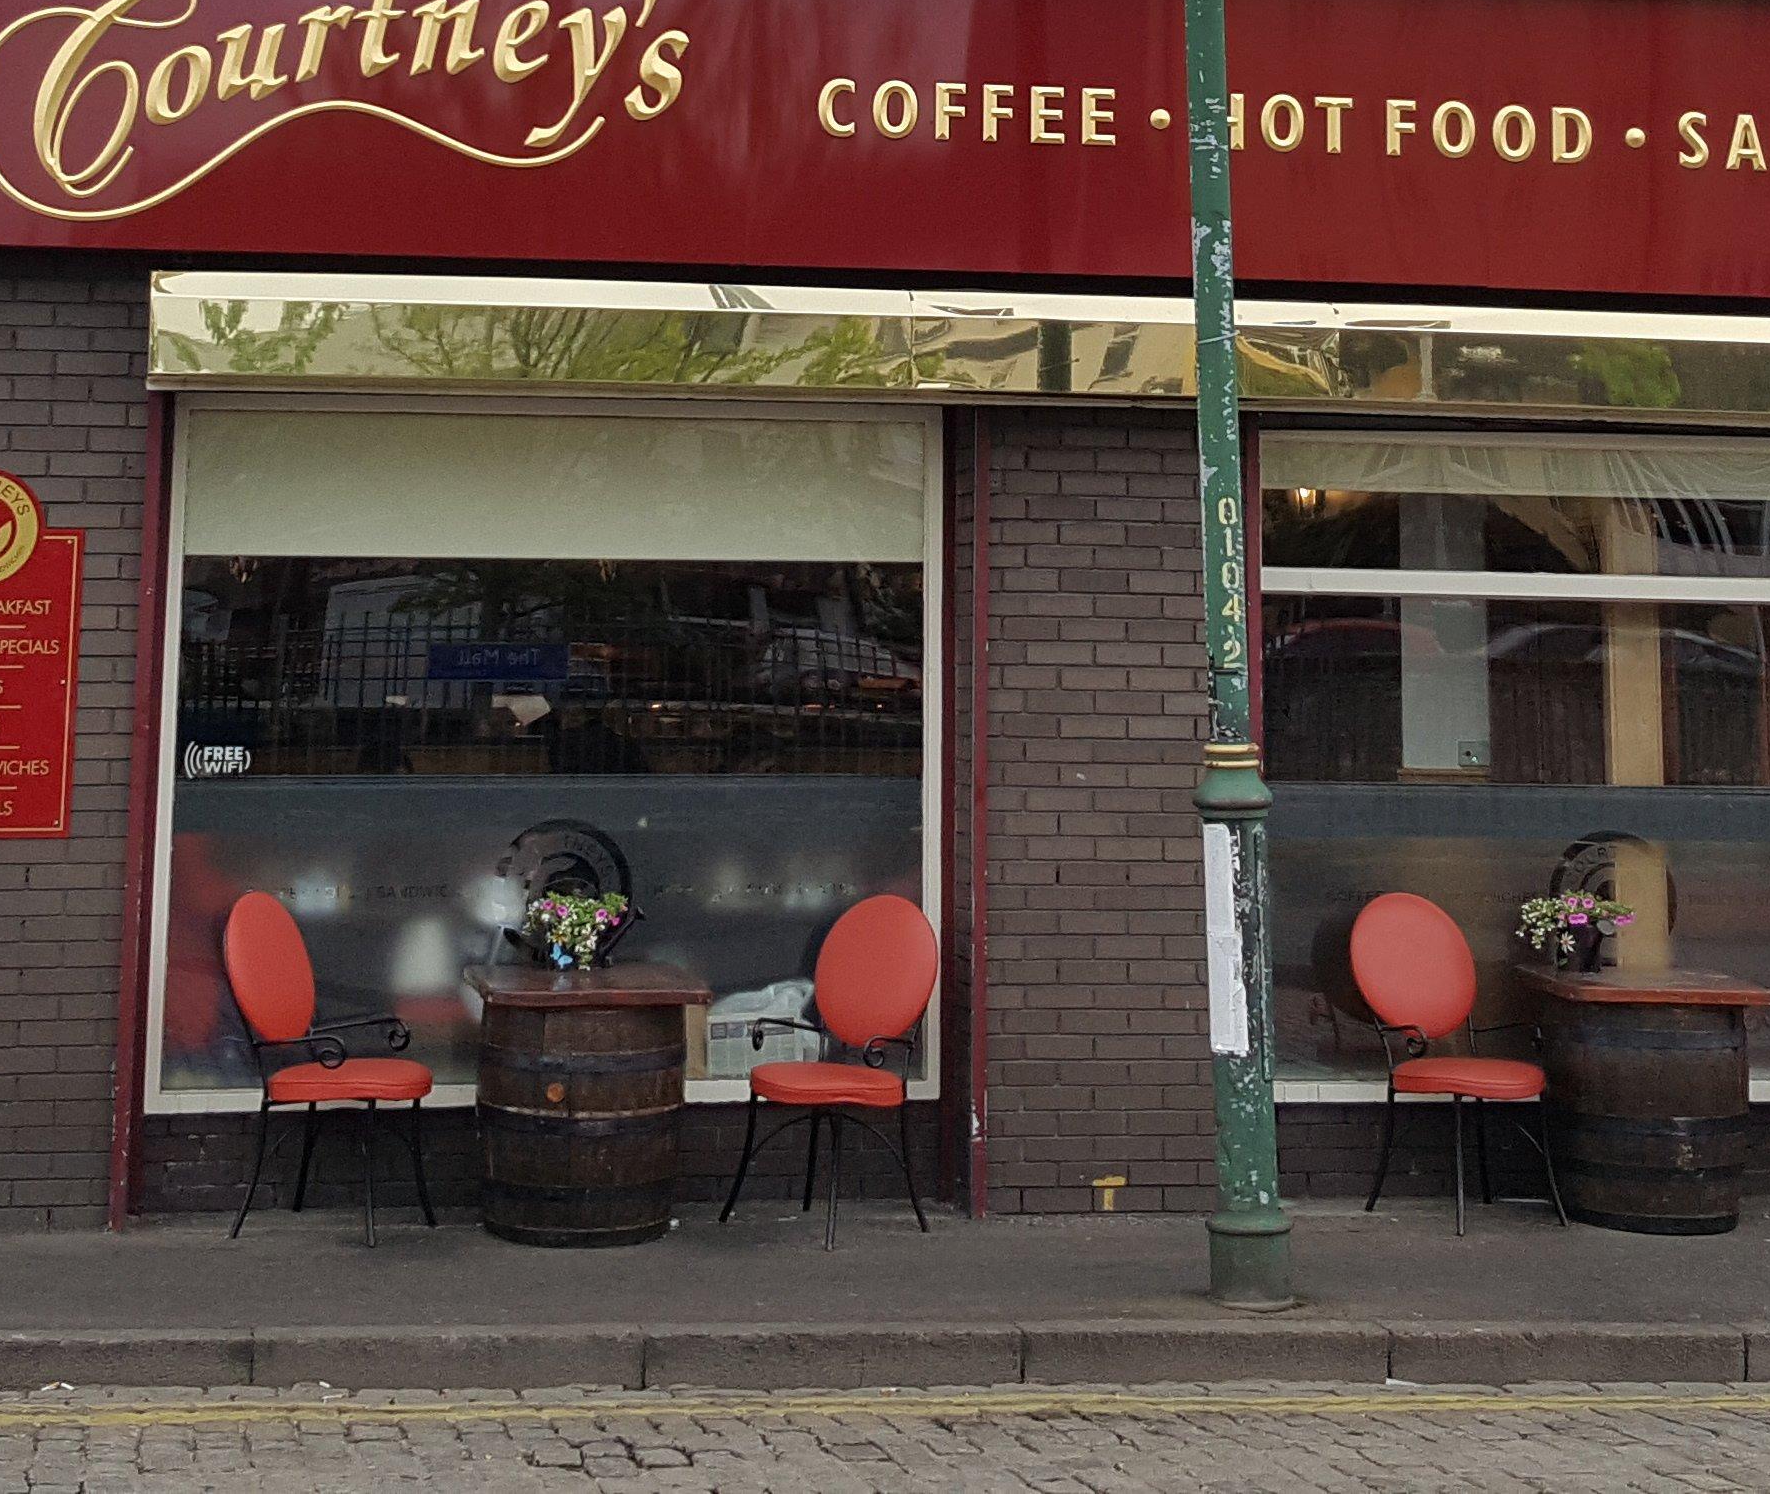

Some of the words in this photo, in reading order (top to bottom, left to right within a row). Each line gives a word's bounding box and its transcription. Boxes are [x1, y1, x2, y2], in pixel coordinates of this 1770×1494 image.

[818, 78, 1117, 146] COFFEE
[1385, 99, 1593, 164] FOOD
[203, 746, 244, 761] FREE
